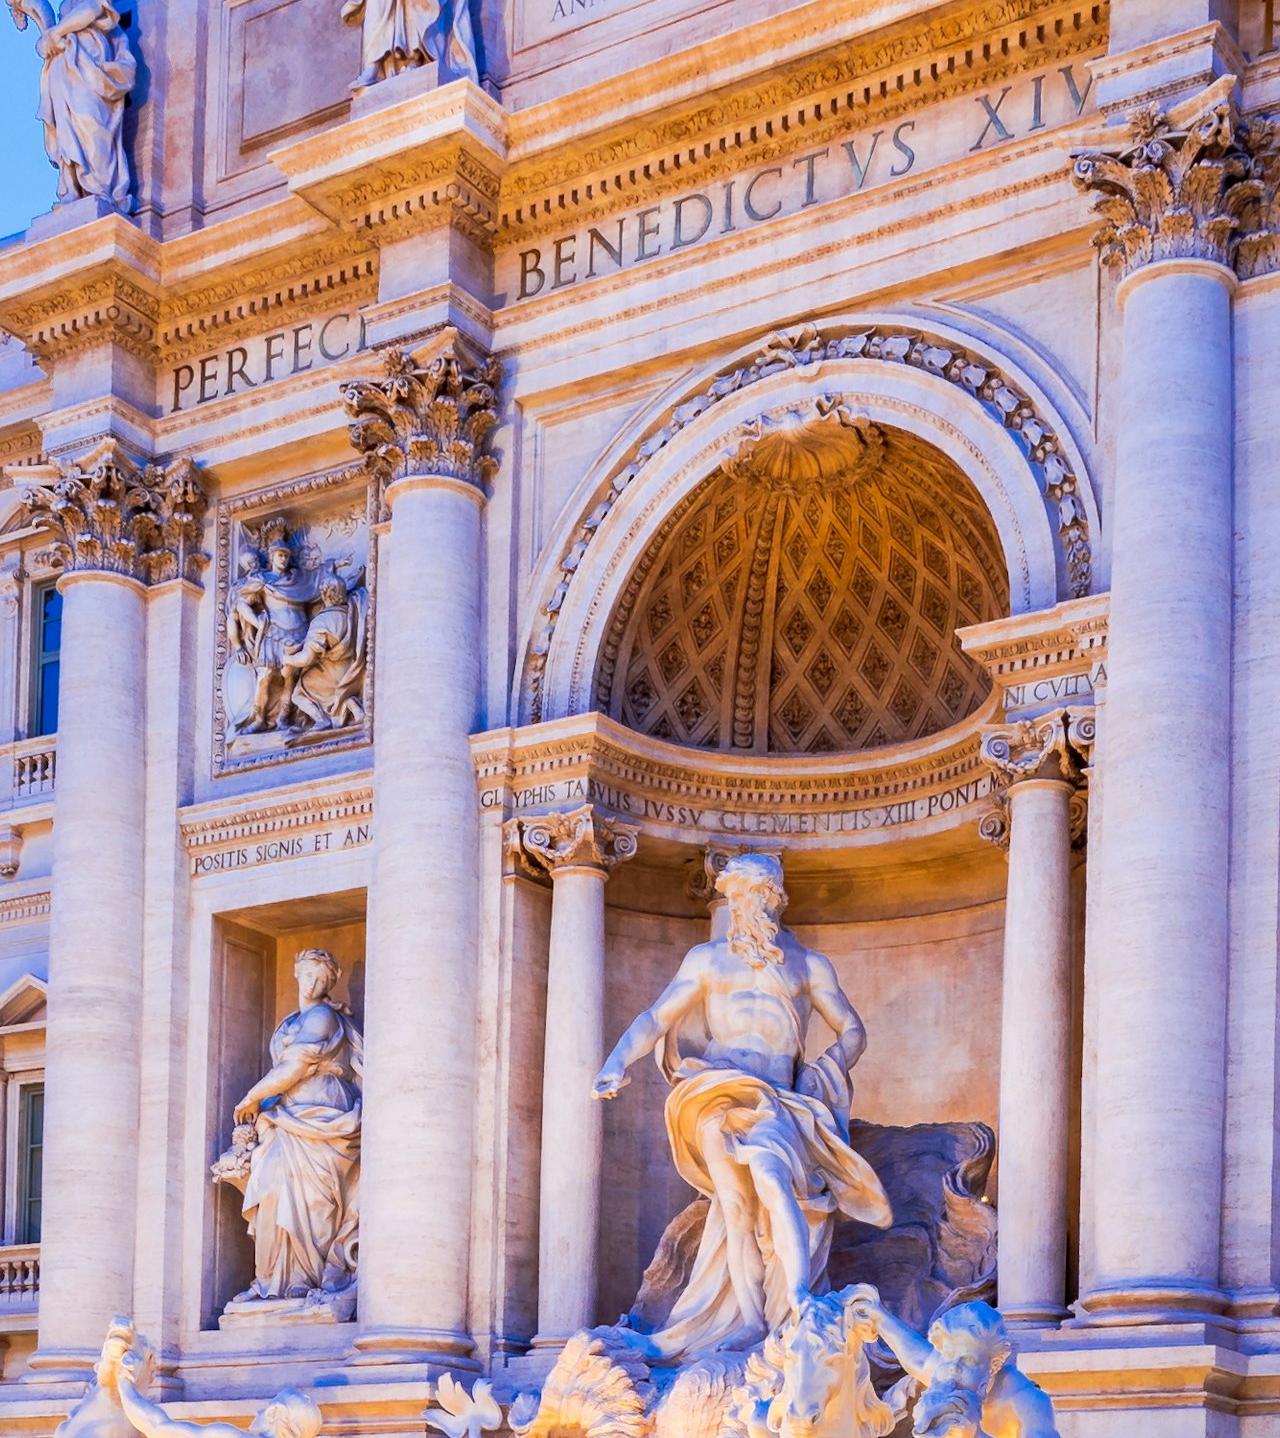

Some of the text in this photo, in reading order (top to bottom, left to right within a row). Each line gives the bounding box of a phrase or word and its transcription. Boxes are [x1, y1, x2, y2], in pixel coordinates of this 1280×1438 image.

[516, 120, 916, 301] BENEDICTVS
[564, 777, 631, 811] TABVLIS
[643, 799, 704, 826] IVSSV
[194, 824, 373, 874] POSITIS SIGNIS ET AN
